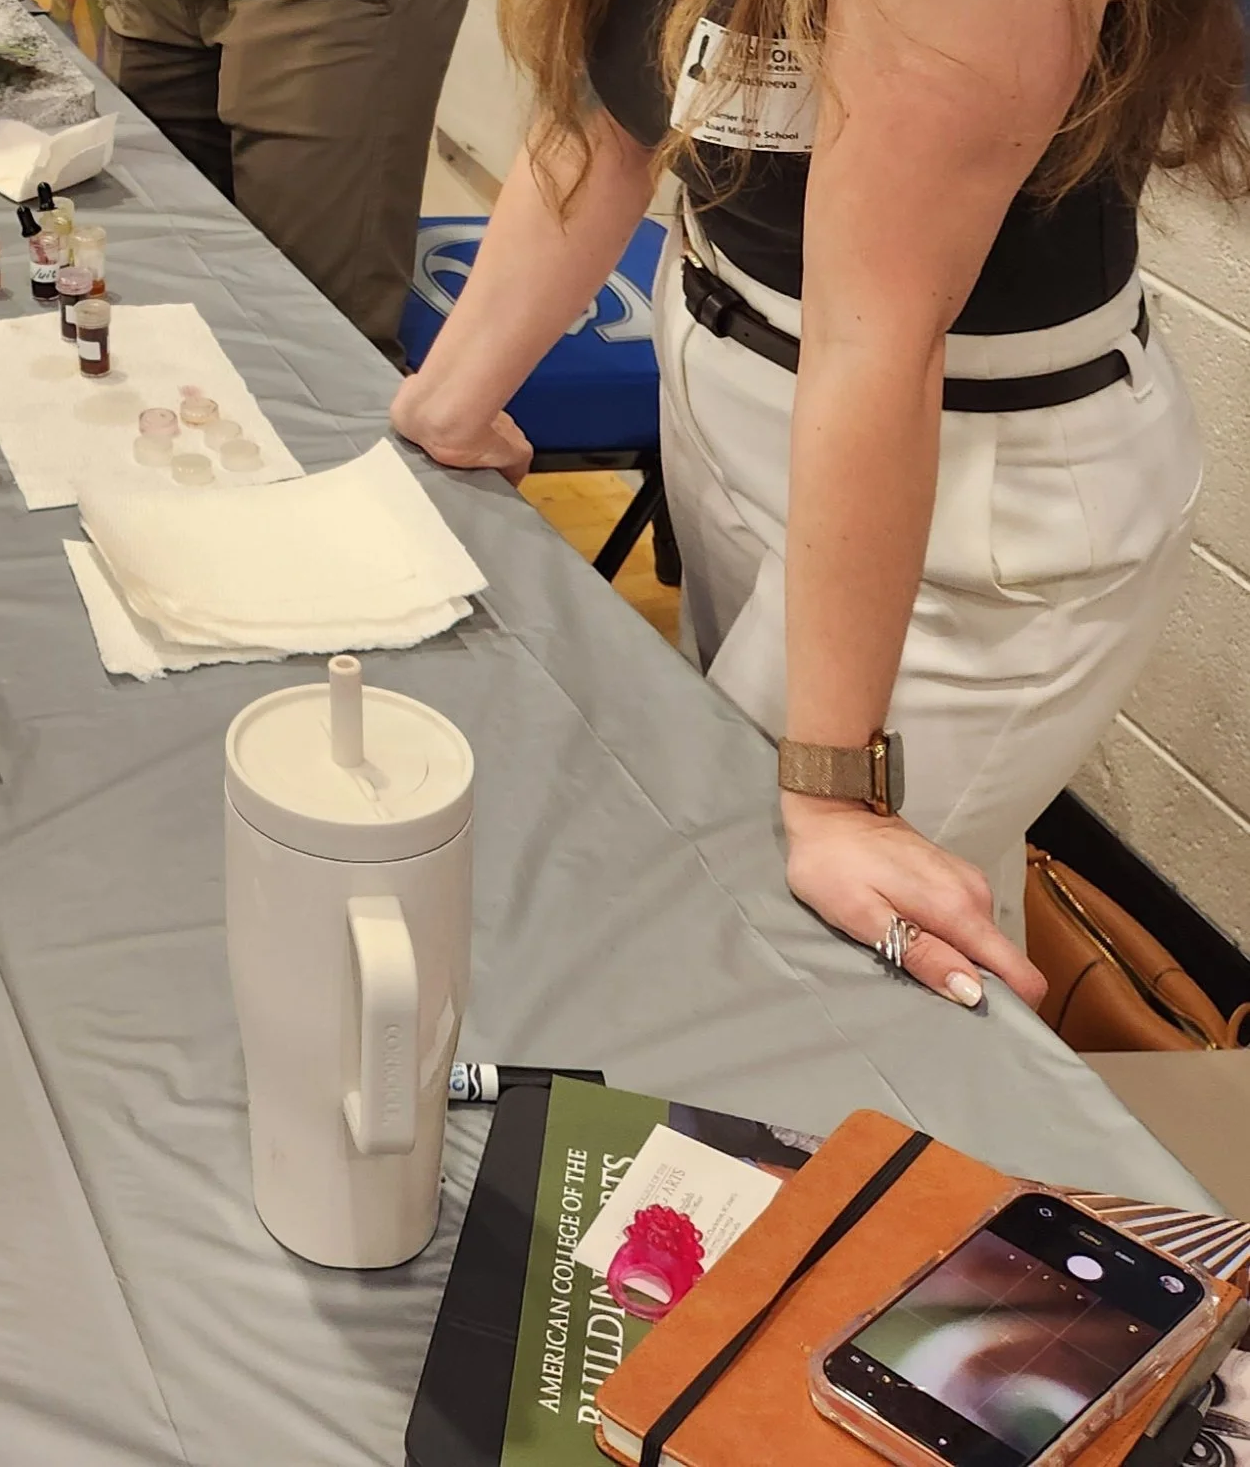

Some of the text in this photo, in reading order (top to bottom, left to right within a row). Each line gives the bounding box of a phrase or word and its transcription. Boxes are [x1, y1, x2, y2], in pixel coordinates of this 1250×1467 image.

[764, 131, 799, 141] School
[659, 1166, 687, 1197] ARTS
[537, 1147, 588, 1414] AMERICAN COLLEGE OF THE
